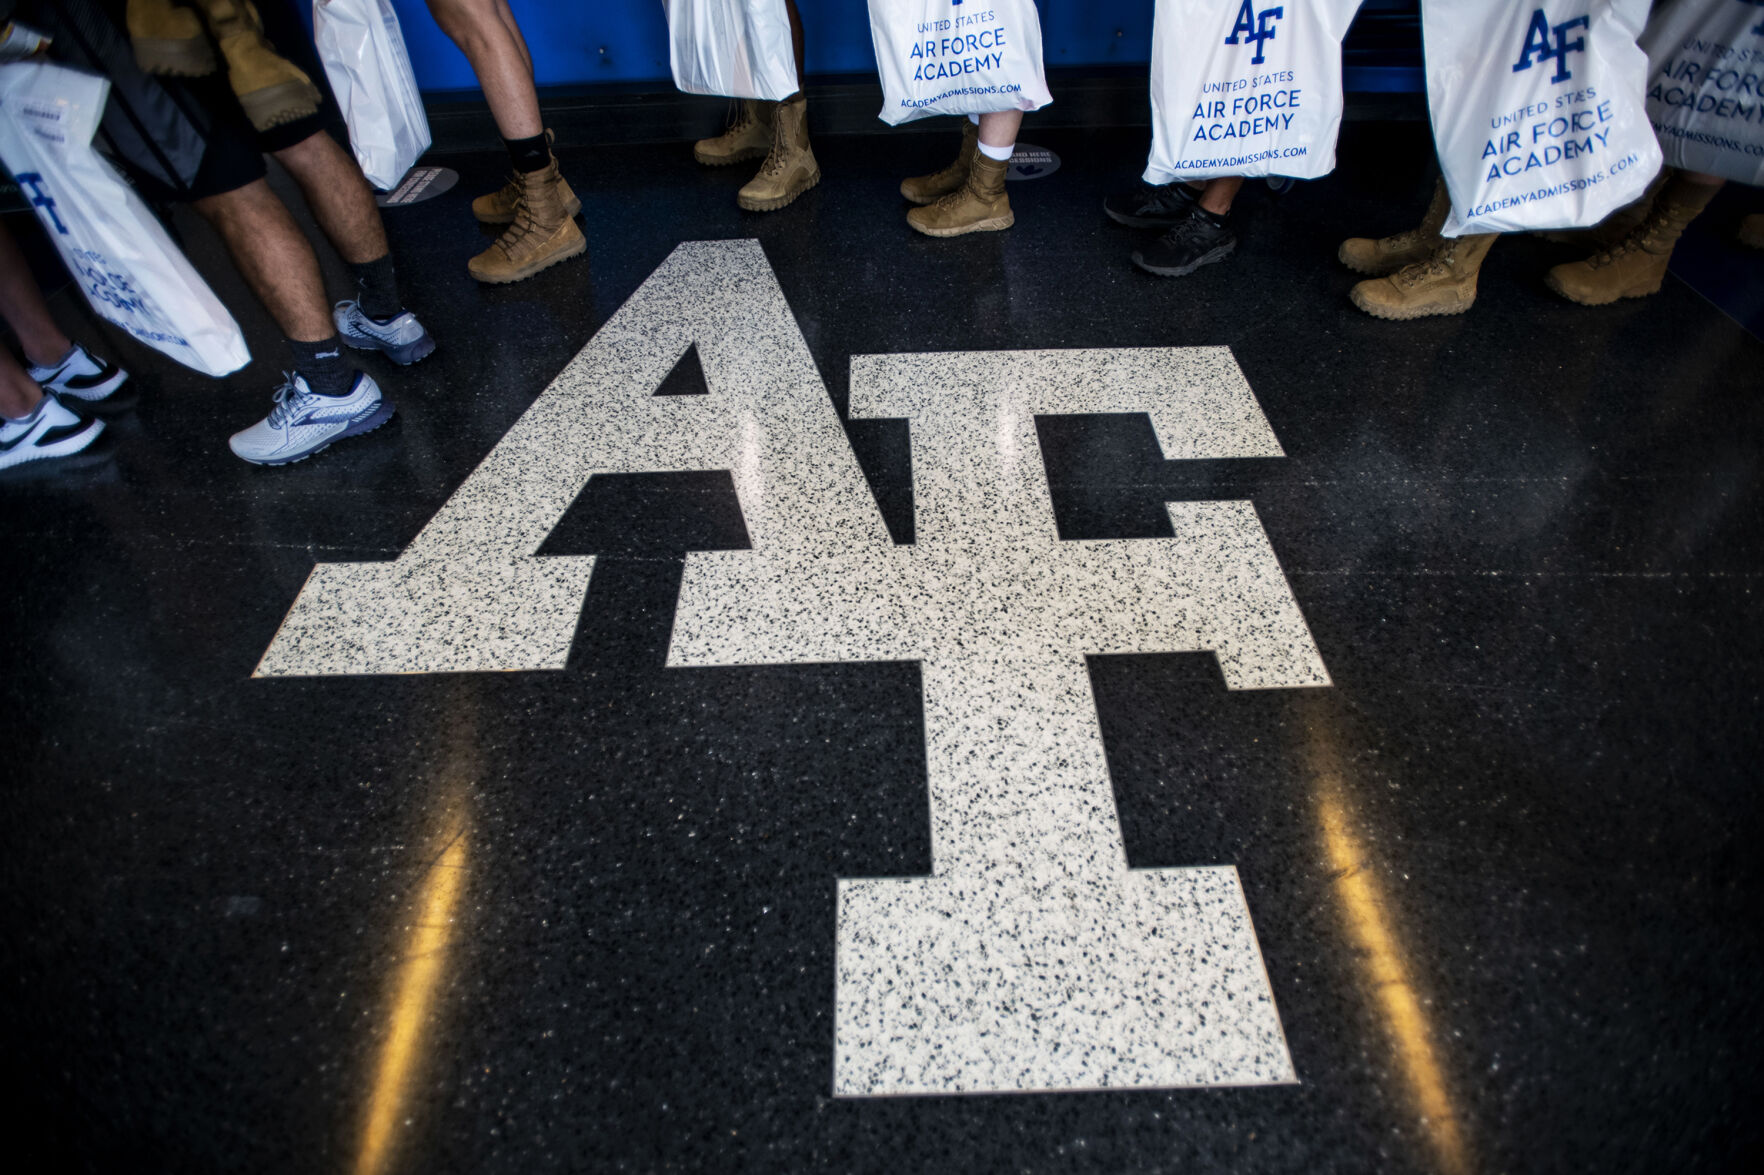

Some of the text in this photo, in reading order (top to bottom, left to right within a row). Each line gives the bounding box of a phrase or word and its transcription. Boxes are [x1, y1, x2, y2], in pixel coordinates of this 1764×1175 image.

[917, 10, 995, 33] UNITED STATES
[1224, 0, 1284, 65] AF
[941, 27, 1006, 57] FORCE
[1512, 8, 1590, 85] AF
[913, 52, 1003, 81] ACADEMY
[1662, 58, 1701, 84] AIR
[900, 83, 1022, 108] ACADEMYADMISSIONS.COM
[1203, 70, 1294, 94] UNITED STATES
[1192, 89, 1302, 120] AIR FORCE
[1491, 101, 1548, 129] UNITED
[1193, 112, 1295, 142] ACADEMY
[1174, 146, 1307, 170] ACADEMYADMISSIONS.COM
[1481, 130, 1522, 160] AIR
[1486, 126, 1611, 183] ACADEMY
[1466, 153, 1639, 219] ACADEMYADMISSONS.COM
[252, 238, 1333, 1098] AF
